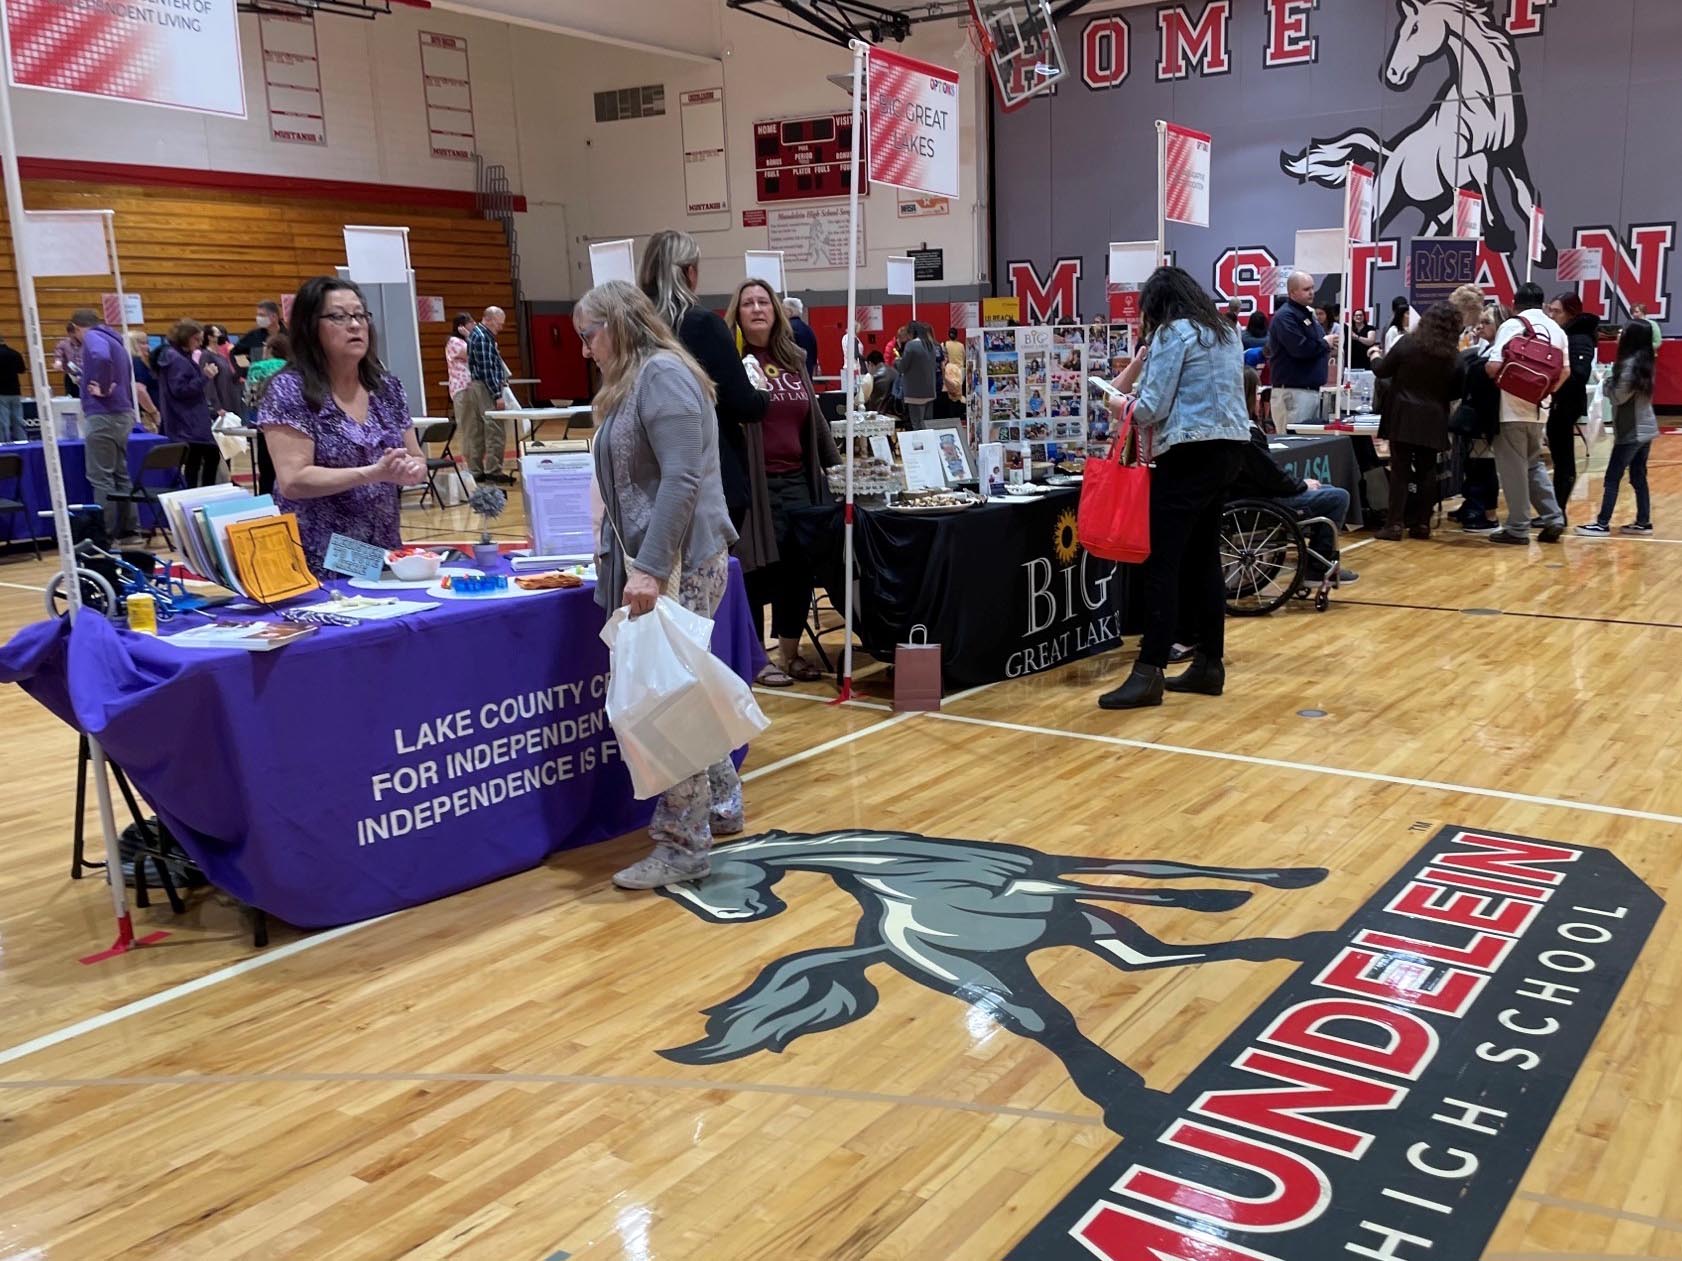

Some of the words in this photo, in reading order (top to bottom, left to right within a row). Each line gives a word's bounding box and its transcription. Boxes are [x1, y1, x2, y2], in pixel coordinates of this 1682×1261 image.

[158, 12, 201, 32] LIVING
[193, 1, 212, 14] OF
[1005, 0, 1319, 98] HOME
[757, 124, 778, 135] HOME
[880, 93, 901, 118] BIG
[905, 102, 948, 131] GREAT
[836, 152, 852, 160] BONU
[894, 131, 935, 158] LAKES
[814, 165, 831, 174] FOULS
[1007, 221, 1676, 326] MSTAN
[1415, 243, 1473, 282] RISE
[1020, 549, 1118, 638] BIG
[1005, 631, 1071, 678] GREAT
[394, 710, 474, 754] LAKE
[480, 681, 584, 729] COUNTY
[371, 760, 439, 801] FOR
[446, 708, 612, 779] INDEPENDEN
[357, 755, 574, 846] INDEPENDENCE
[580, 747, 596, 774] IS
[1344, 1096, 1508, 1261] HIGH
[1475, 905, 1628, 1070] SCHOOL
